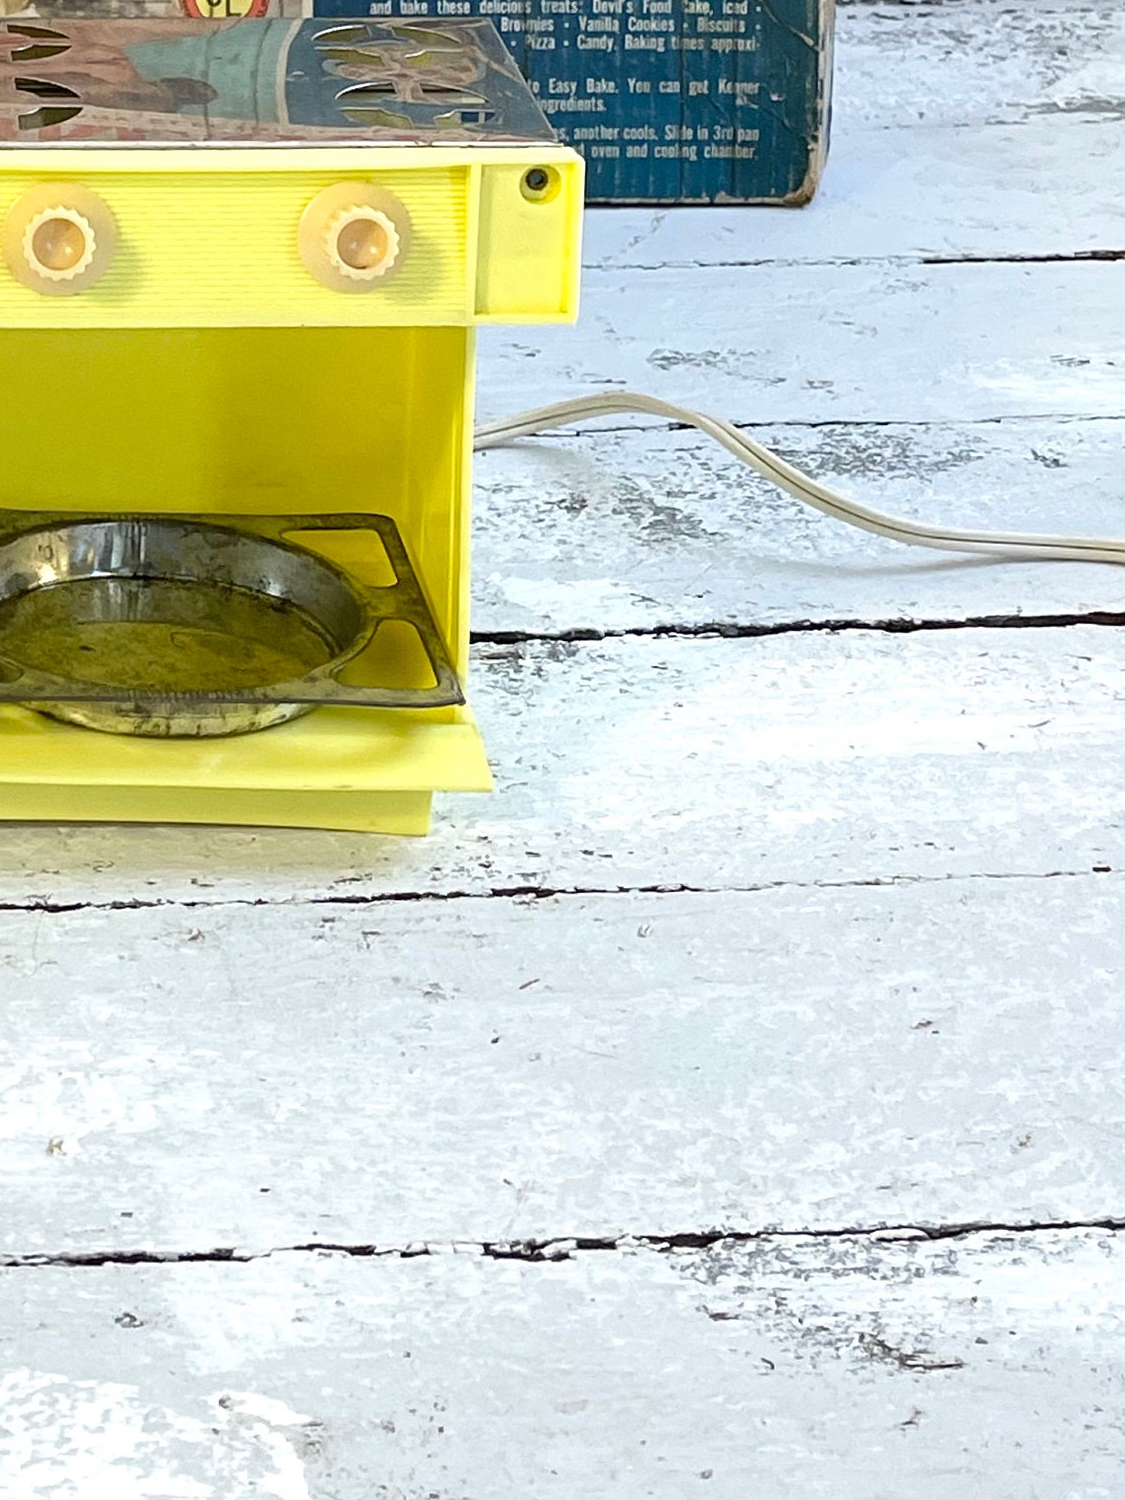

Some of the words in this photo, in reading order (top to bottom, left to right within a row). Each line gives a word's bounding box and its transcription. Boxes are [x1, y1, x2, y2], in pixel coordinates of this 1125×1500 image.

[370, 0, 392, 15] and
[400, 0, 429, 15] bake
[437, 0, 471, 15] these
[578, 15, 620, 33] Vanilla
[627, 15, 675, 33] Cookies
[624, 34, 666, 53] Baking
[547, 77, 577, 96] Easy
[586, 78, 620, 95] Bake.
[627, 77, 651, 94] You
[659, 80, 681, 95] can
[688, 79, 709, 97] get
[573, 125, 621, 141] another
[623, 125, 659, 142] cools.
[697, 124, 709, 141] in
[713, 124, 734, 142] 3rd
[737, 126, 761, 144] pan
[590, 145, 621, 159] oven
[626, 143, 649, 159] and
